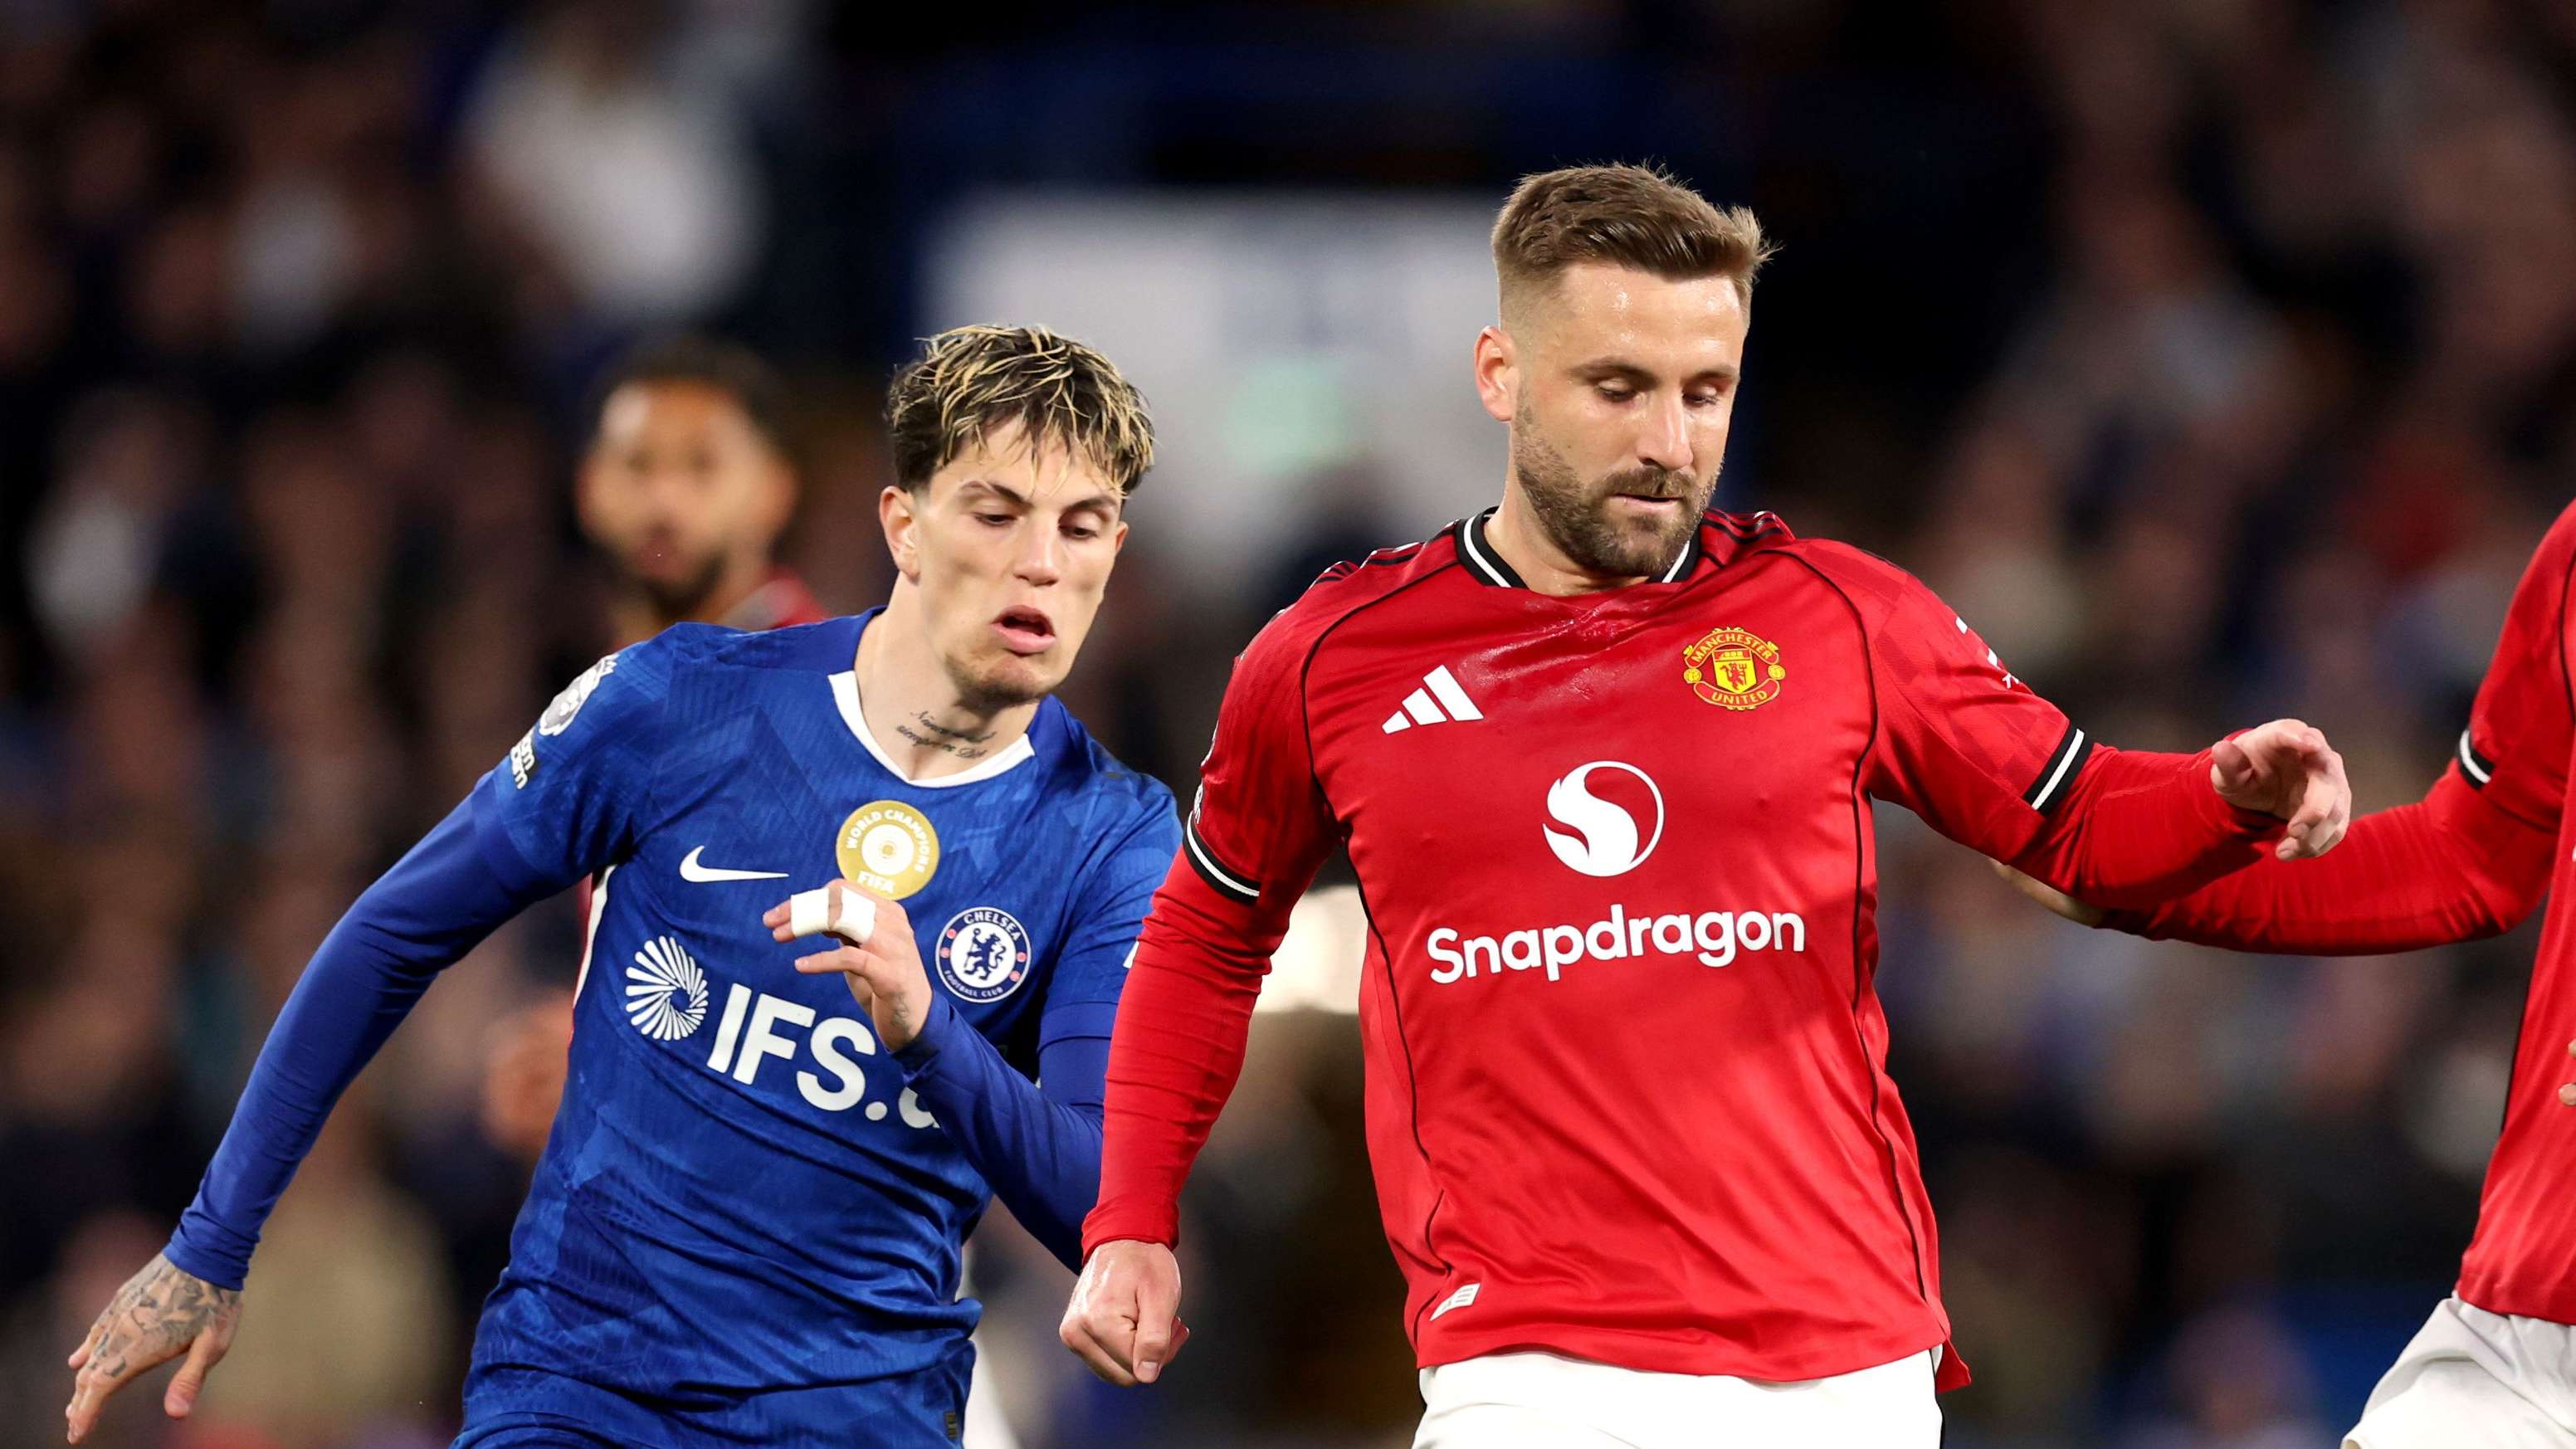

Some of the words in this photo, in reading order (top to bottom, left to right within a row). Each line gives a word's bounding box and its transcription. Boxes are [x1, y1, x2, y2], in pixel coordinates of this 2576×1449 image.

[1691, 633, 1773, 663] MANCHESTER
[1711, 690, 1768, 705] UNITED
[846, 810, 882, 850] WORLD
[884, 809, 930, 873] CHAMPIONS
[857, 870, 896, 894] FIFA
[963, 910, 1022, 940] CHELSEA
[1427, 903, 1806, 984] Snapdragon
[944, 969, 978, 998] FOOTBALL
[981, 987, 1003, 998] CLUB
